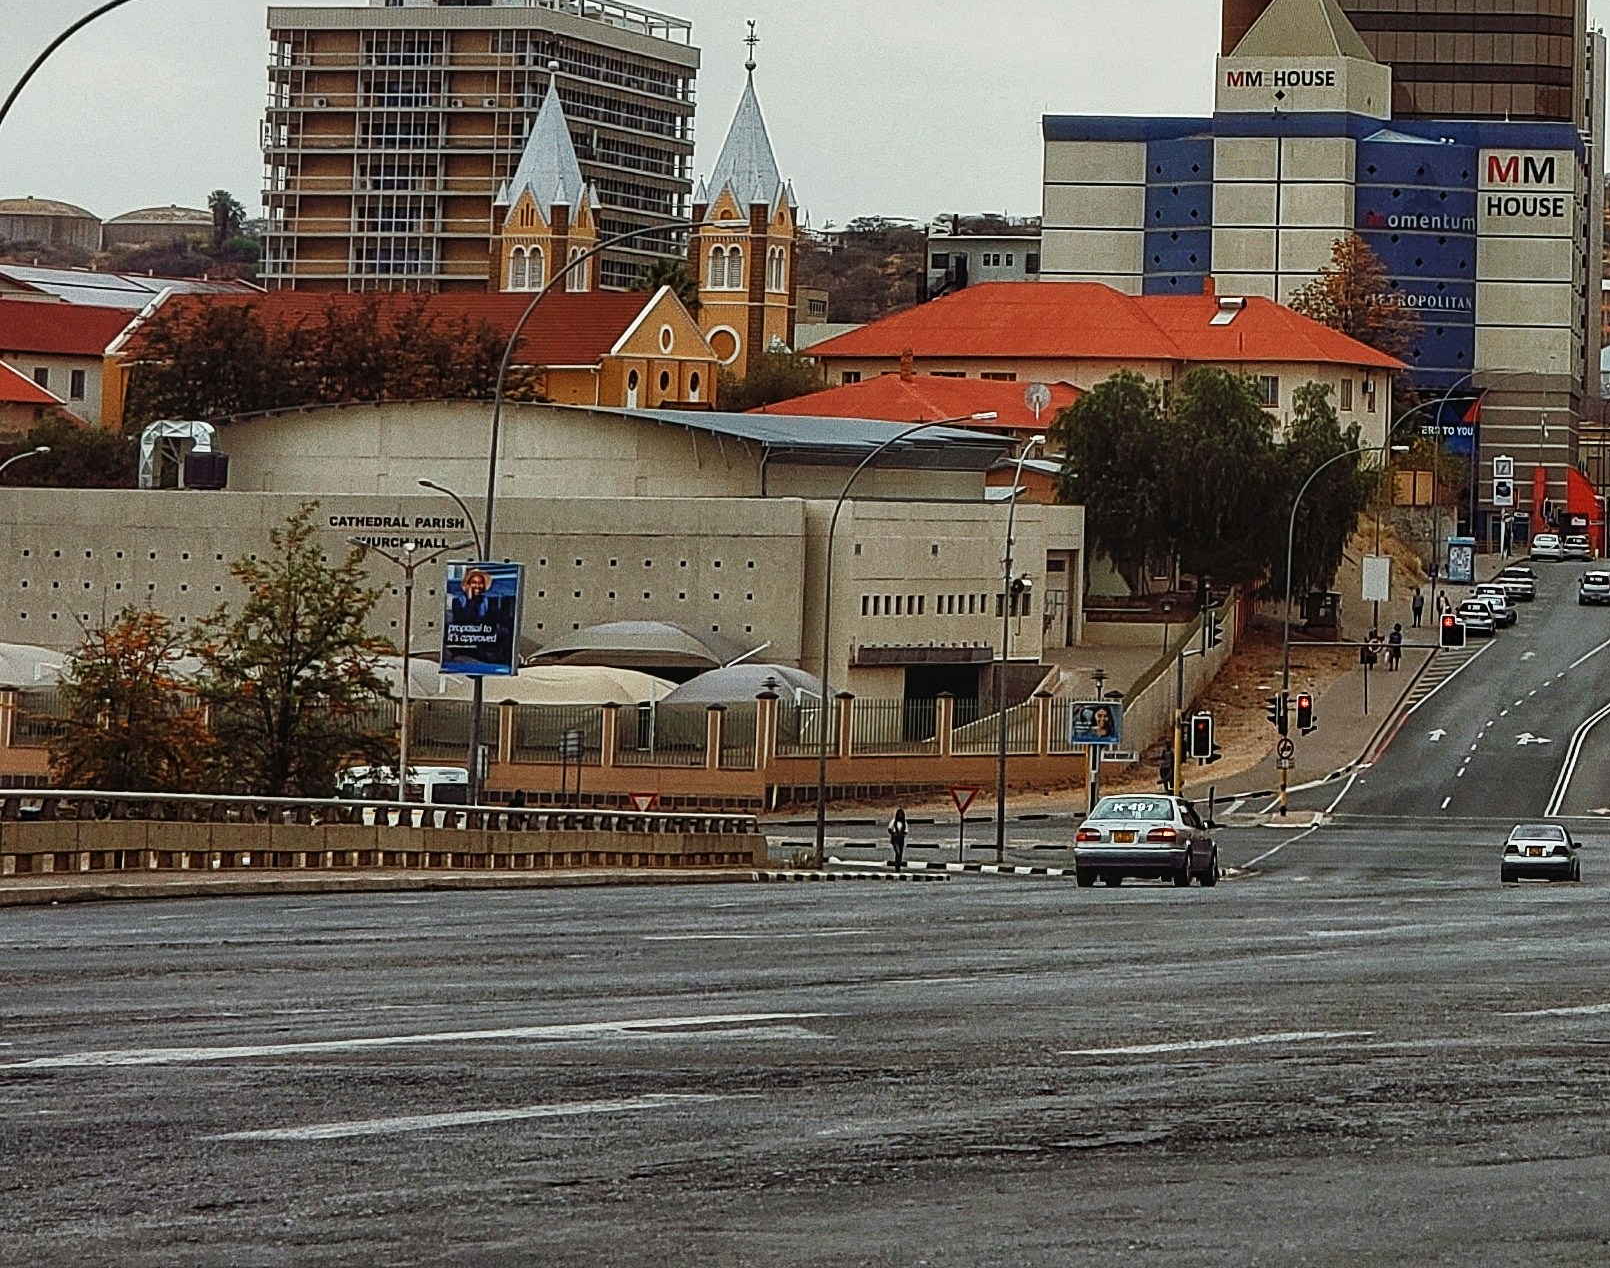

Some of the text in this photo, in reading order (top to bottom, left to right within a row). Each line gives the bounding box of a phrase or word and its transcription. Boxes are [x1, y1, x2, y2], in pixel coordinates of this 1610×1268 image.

[1274, 71, 1335, 87] HOUSE
[1487, 155, 1555, 184] MM
[1487, 196, 1565, 217] HOUSE
[1442, 426, 1455, 435] TO
[1457, 426, 1474, 436] YOU
[329, 516, 465, 528] CATHEDRAL PARISH
[415, 537, 449, 548] HALL
